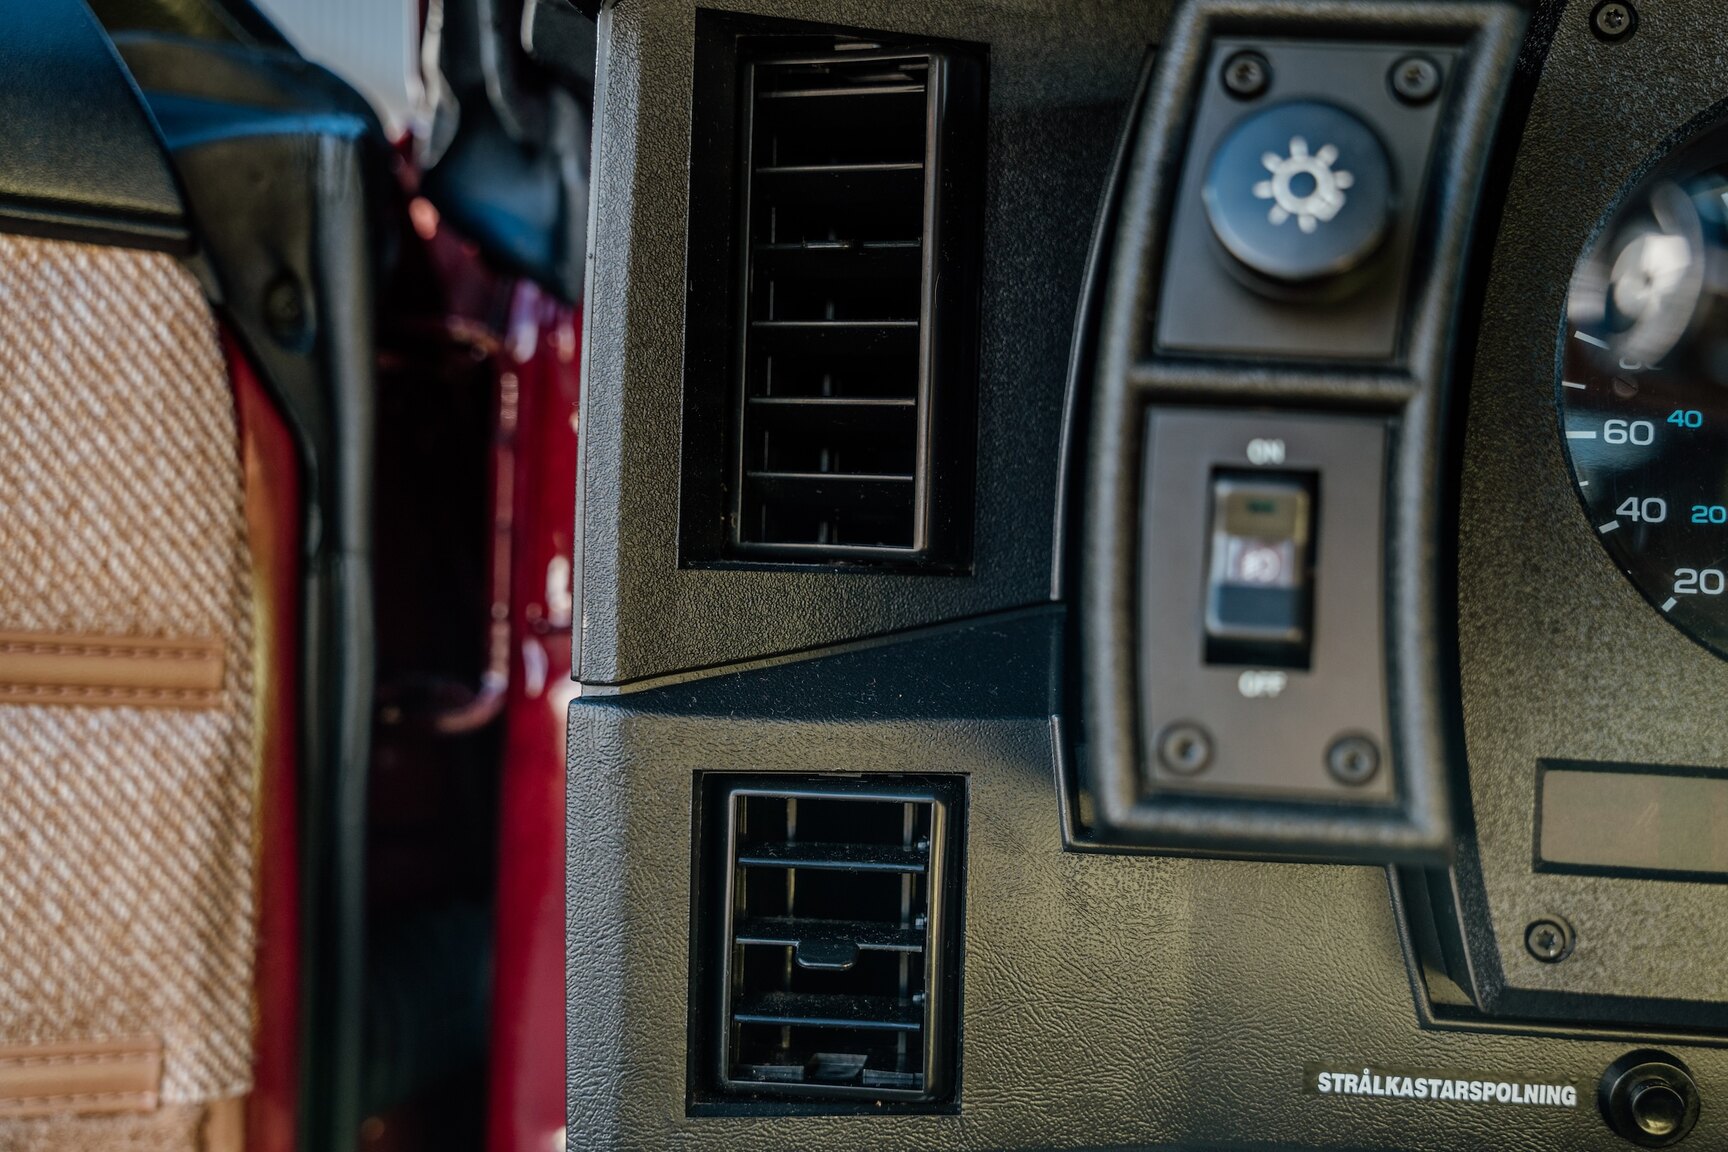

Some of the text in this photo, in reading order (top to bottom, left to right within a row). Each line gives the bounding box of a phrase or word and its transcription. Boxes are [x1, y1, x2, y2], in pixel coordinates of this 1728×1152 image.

[1603, 419, 1655, 445] 60
[1667, 410, 1702, 428] 40
[1247, 438, 1286, 464] ON
[1616, 496, 1666, 523] 40
[1691, 505, 1726, 524] 20
[1674, 568, 1725, 595] 20
[1317, 1068, 1577, 1107] STRÅLKASTARSPOLNING
